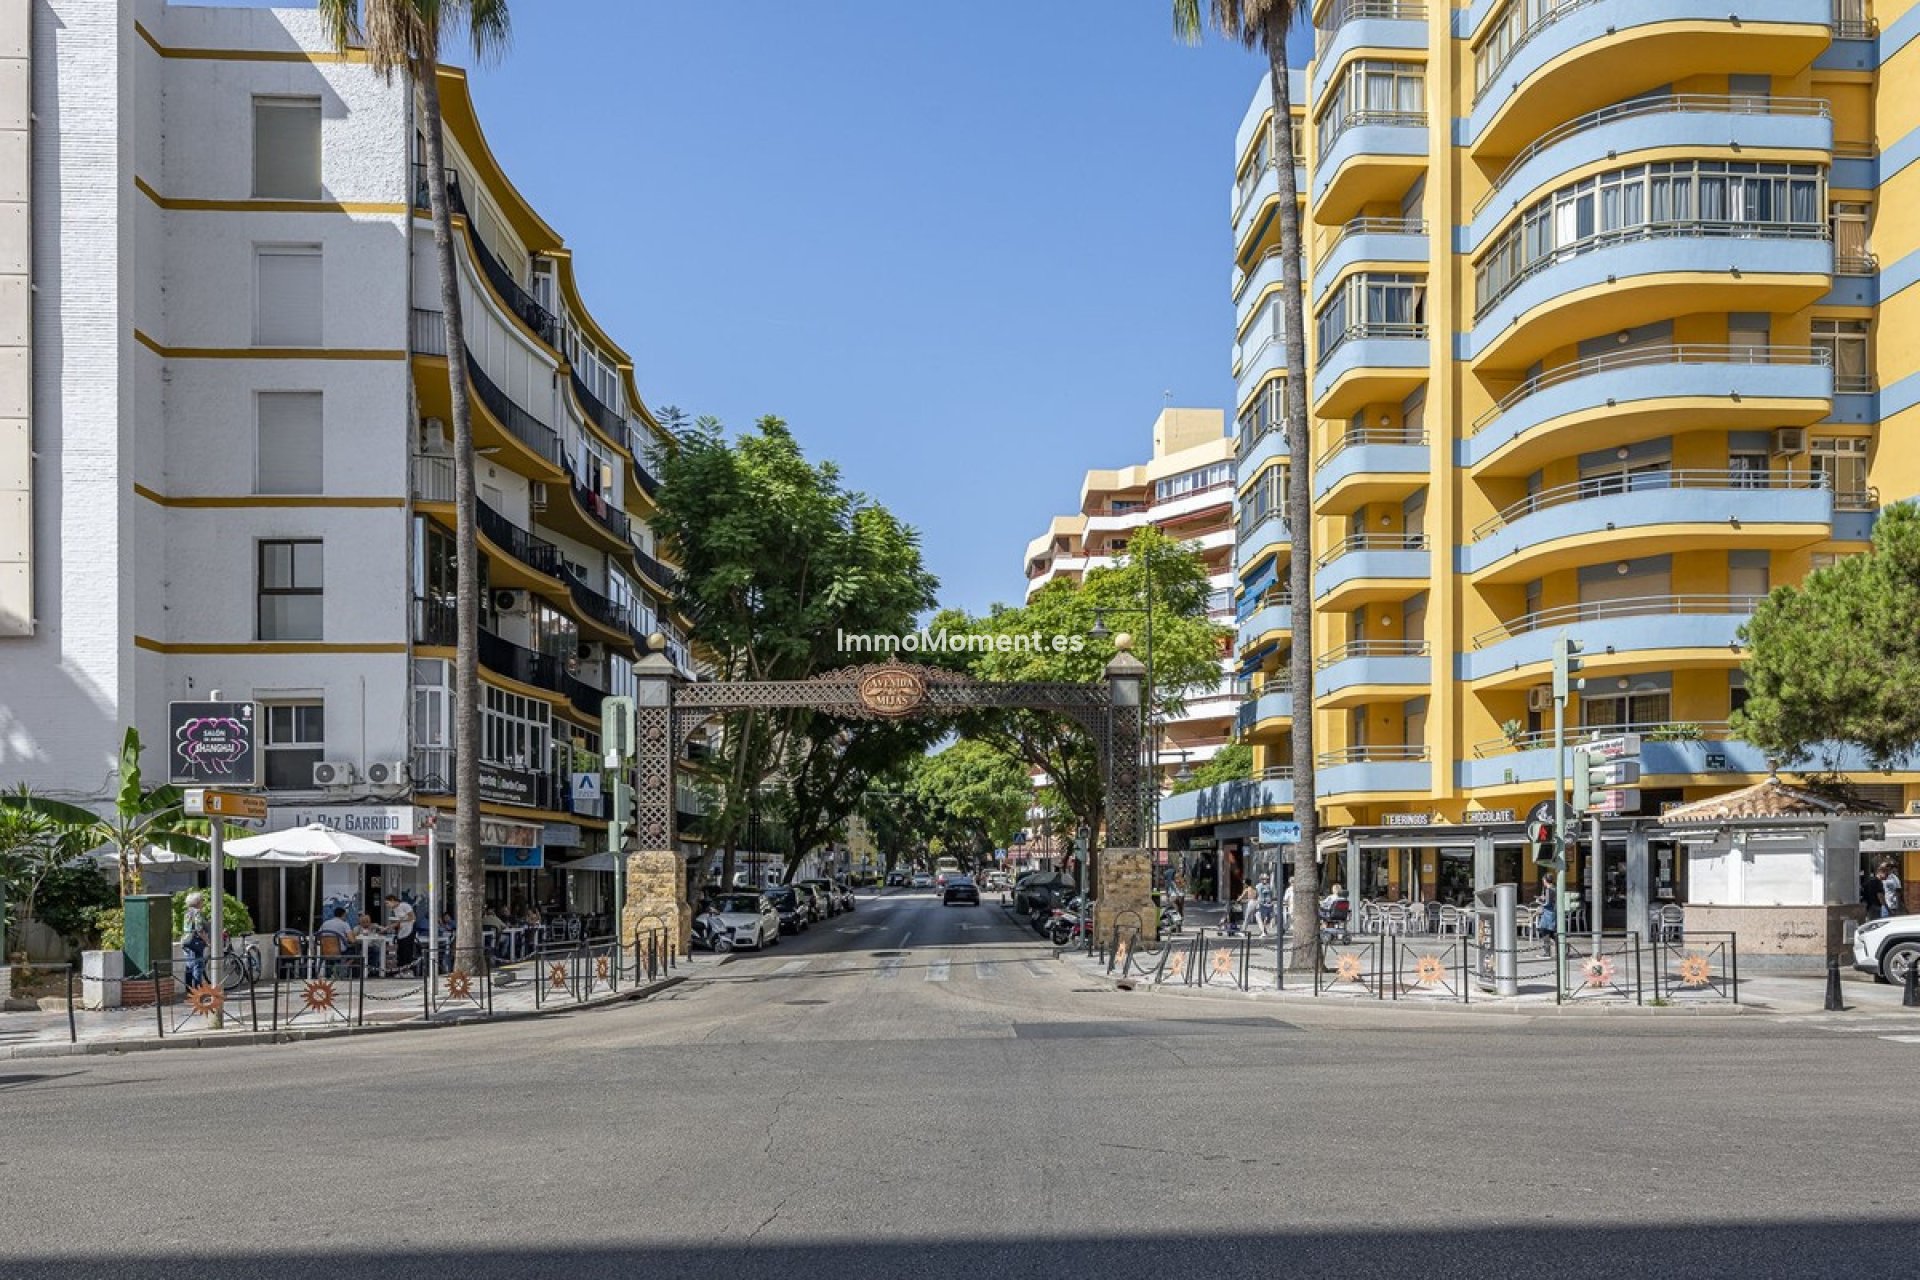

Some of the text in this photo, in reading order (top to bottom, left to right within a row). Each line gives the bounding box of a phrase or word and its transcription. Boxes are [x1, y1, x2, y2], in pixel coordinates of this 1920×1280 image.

[870, 677, 914, 687] AVENIDA
[876, 695, 908, 705] MIJAS
[345, 813, 399, 830] GARRIDO
[1466, 811, 1510, 822] CHOCOLATE
